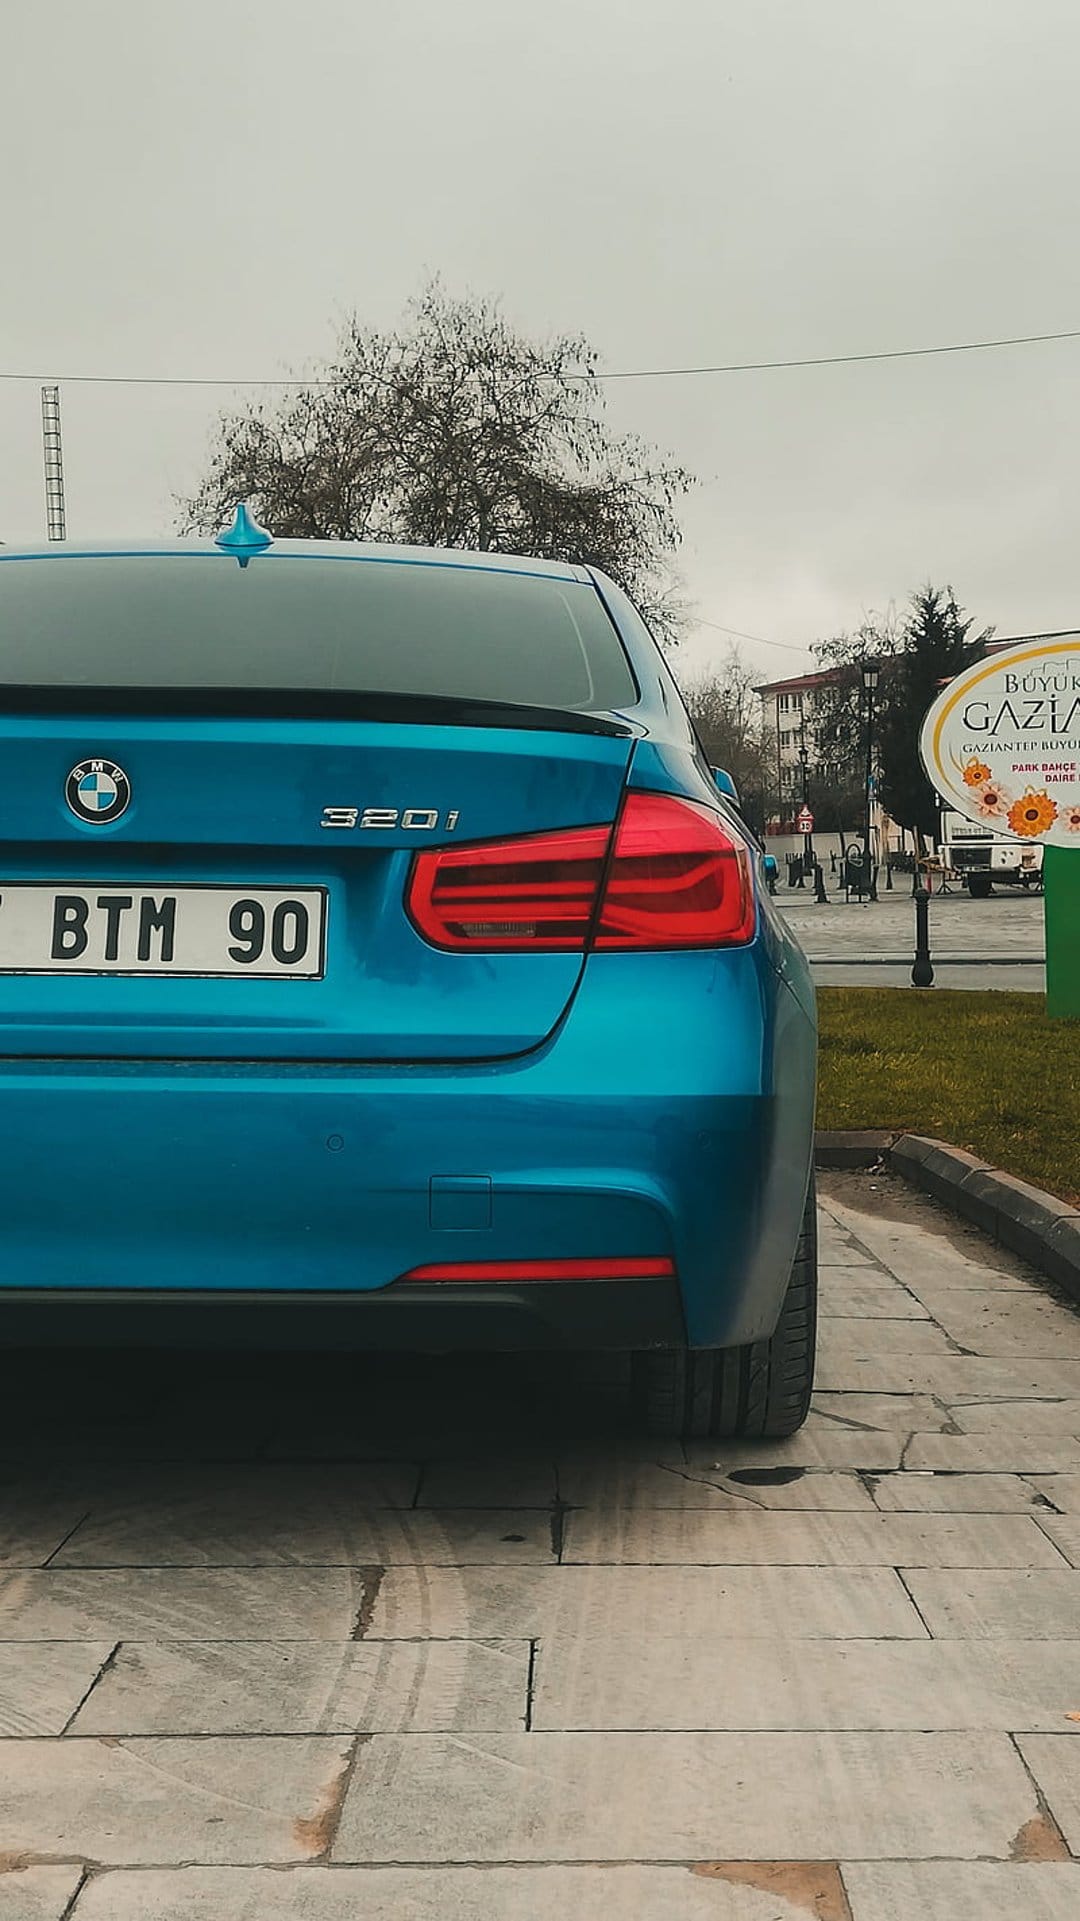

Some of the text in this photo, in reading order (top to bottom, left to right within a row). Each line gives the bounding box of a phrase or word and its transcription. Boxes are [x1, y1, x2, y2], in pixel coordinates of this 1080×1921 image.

[72, 761, 124, 782] BMW
[1011, 763, 1039, 772] PARK
[1041, 762, 1077, 772] BAHÇE
[320, 806, 459, 831] 320i
[50, 895, 309, 965] BTM 90
